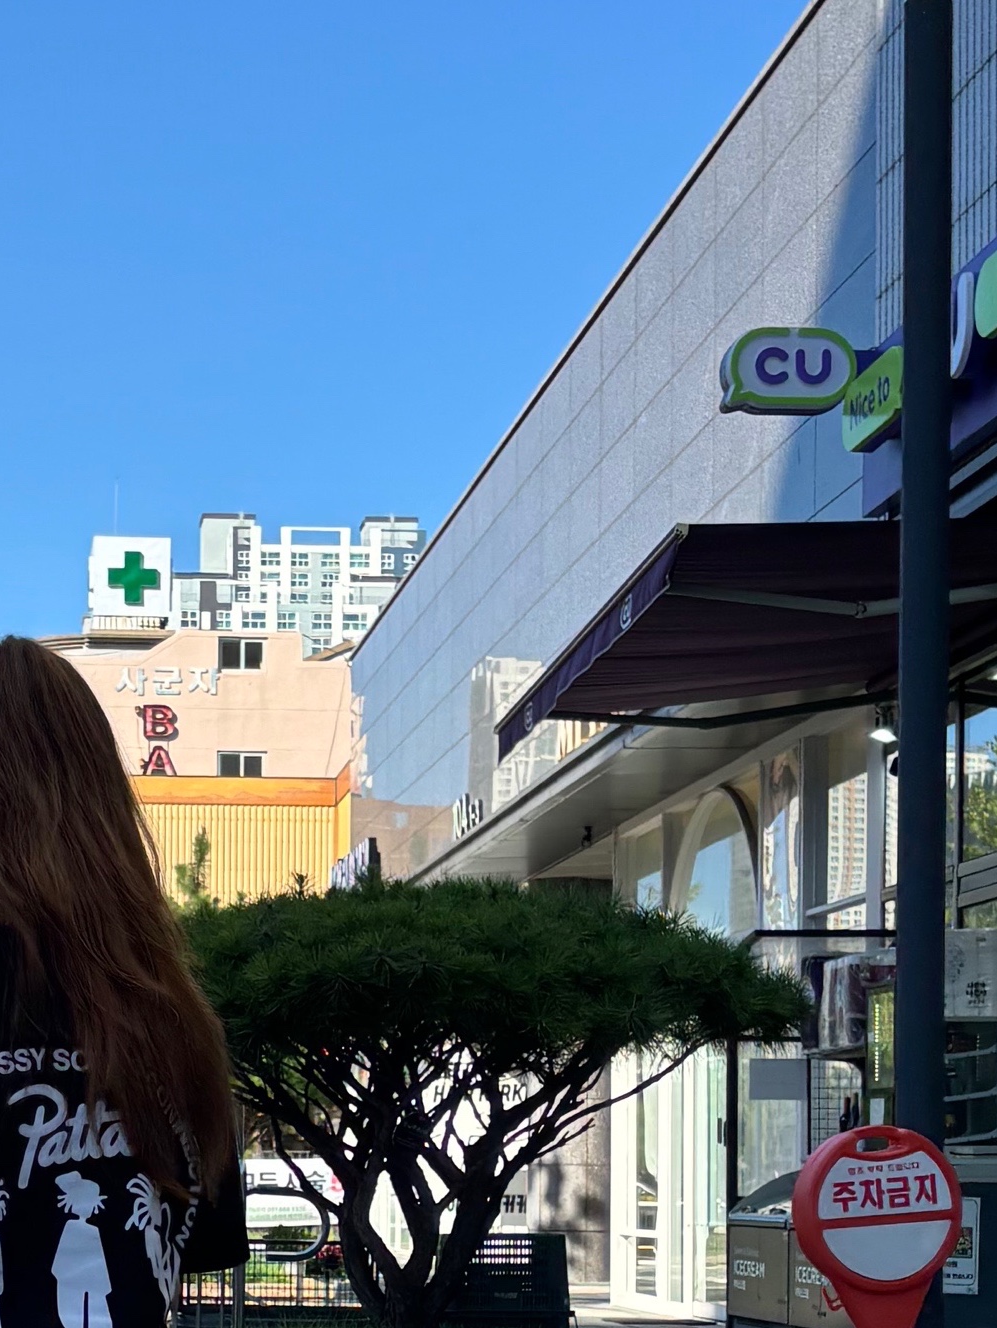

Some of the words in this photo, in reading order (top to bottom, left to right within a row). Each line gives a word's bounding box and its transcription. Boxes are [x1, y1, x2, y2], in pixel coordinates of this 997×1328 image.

[756, 347, 832, 385] CU
[850, 389, 875, 431] Nice
[878, 376, 890, 407] to
[116, 667, 221, 696] 사군자
[7, 1083, 134, 1189] Patta
